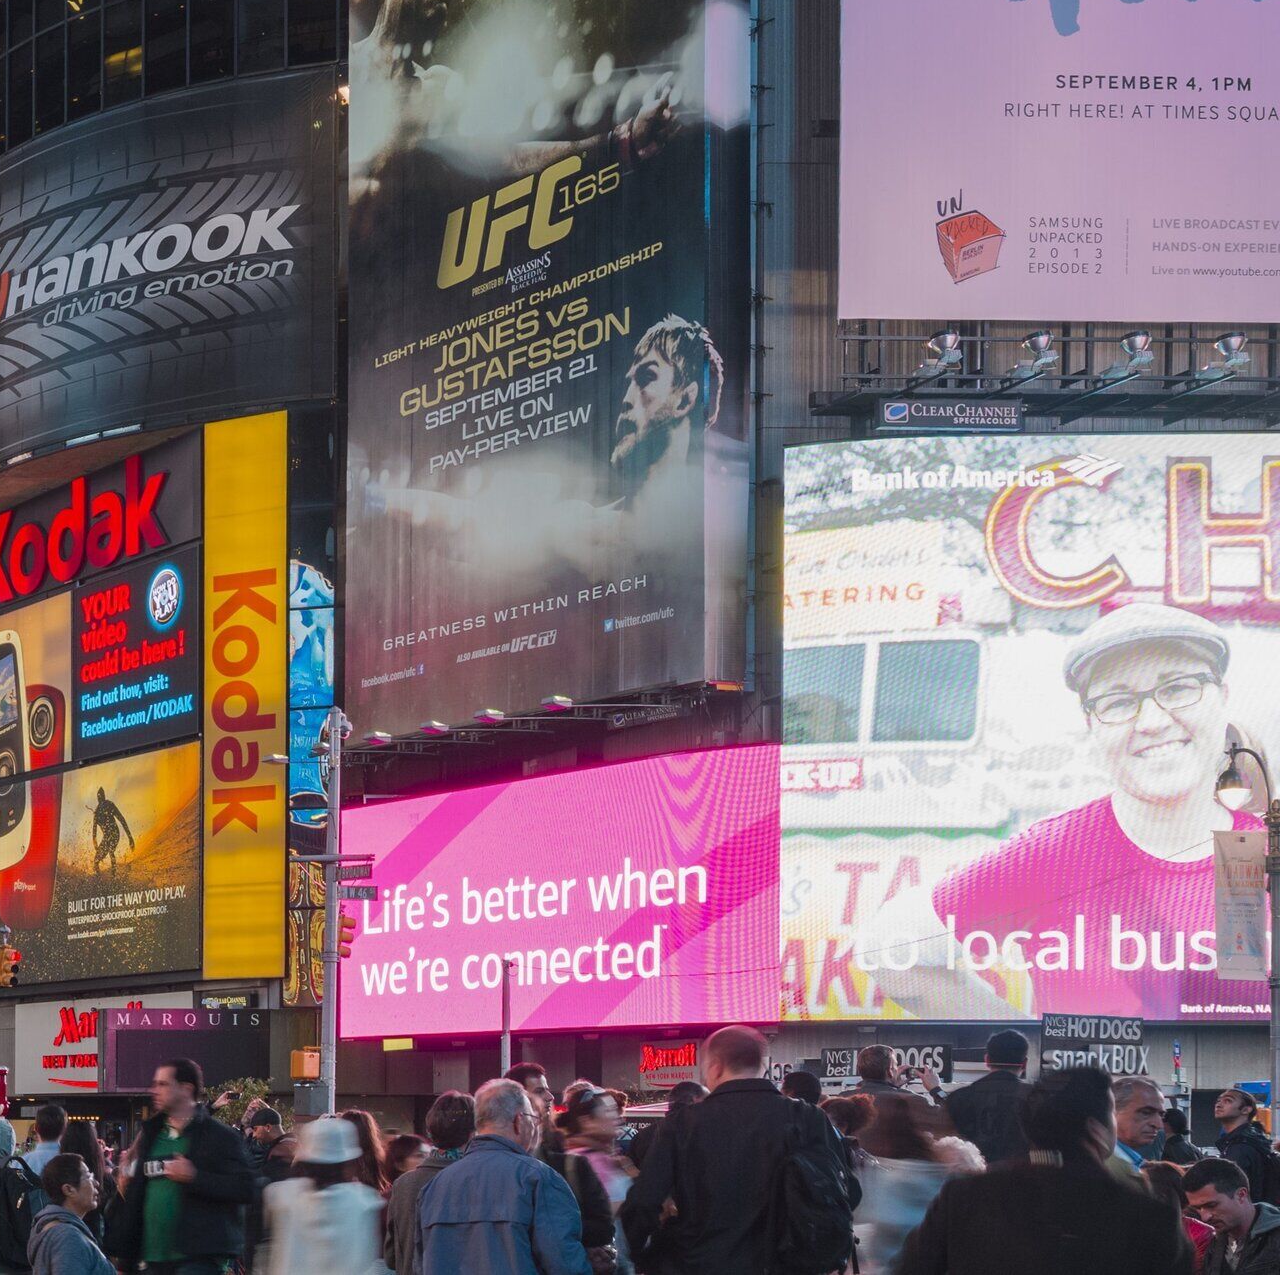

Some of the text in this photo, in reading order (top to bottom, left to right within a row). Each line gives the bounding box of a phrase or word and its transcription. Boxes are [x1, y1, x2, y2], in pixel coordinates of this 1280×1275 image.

[1056, 75, 1252, 92] SEPTEMBER 4, 1PM
[1005, 103, 1060, 118] RIGHT
[1070, 104, 1124, 118] HERE!
[1132, 105, 1155, 119] AT
[1163, 105, 1219, 120] TIMES
[437, 155, 620, 289] UFC 165
[1029, 217, 1103, 228] SAMSUNG
[1152, 218, 1260, 230] LIVE BROADCAST
[1029, 233, 1103, 244] UNPACKED
[1152, 241, 1220, 253] HANDS-ON
[1028, 263, 1103, 274] EPISODE 2
[1152, 265, 1175, 276] Live
[1177, 268, 1191, 276] on
[43, 256, 294, 328] driving emotion
[375, 242, 663, 368] LIGHT HEAVYWEIGHT CHAMPIONSHIP
[434, 309, 539, 374] JONES
[400, 306, 630, 417] GUSTAFSSON
[425, 354, 598, 430] SEPTEMBER 21
[462, 393, 554, 441] LIVE ON
[429, 404, 591, 474] PAY-PER-VIEW
[852, 464, 1055, 491] Bank America
[81, 583, 131, 623] YOUR
[383, 575, 647, 651] GREATNESS WITHIN REACH
[614, 607, 675, 630] twitter.com/ufc
[81, 619, 128, 653] video
[80, 648, 119, 684] could
[471, 644, 501, 661] AVAILABLE
[119, 683, 143, 700] how,
[361, 666, 416, 689] facebook.com/ufc
[81, 694, 193, 738] Facebook.com/KODAK
[211, 568, 277, 837] Kodak
[68, 885, 187, 914] BUILT FOR THE WAY YOU PLAY.
[362, 857, 707, 935] Life's better when
[947, 914, 1085, 971] local
[361, 925, 664, 996] we're connected
[117, 1013, 260, 1027] MARQUIS
[1180, 1003, 1203, 1013] Bank
[1045, 1019, 1141, 1040] best HOT DOGS
[43, 1055, 67, 1069] NEW
[826, 1063, 851, 1077] best
[1112, 1046, 1149, 1075] BOX
